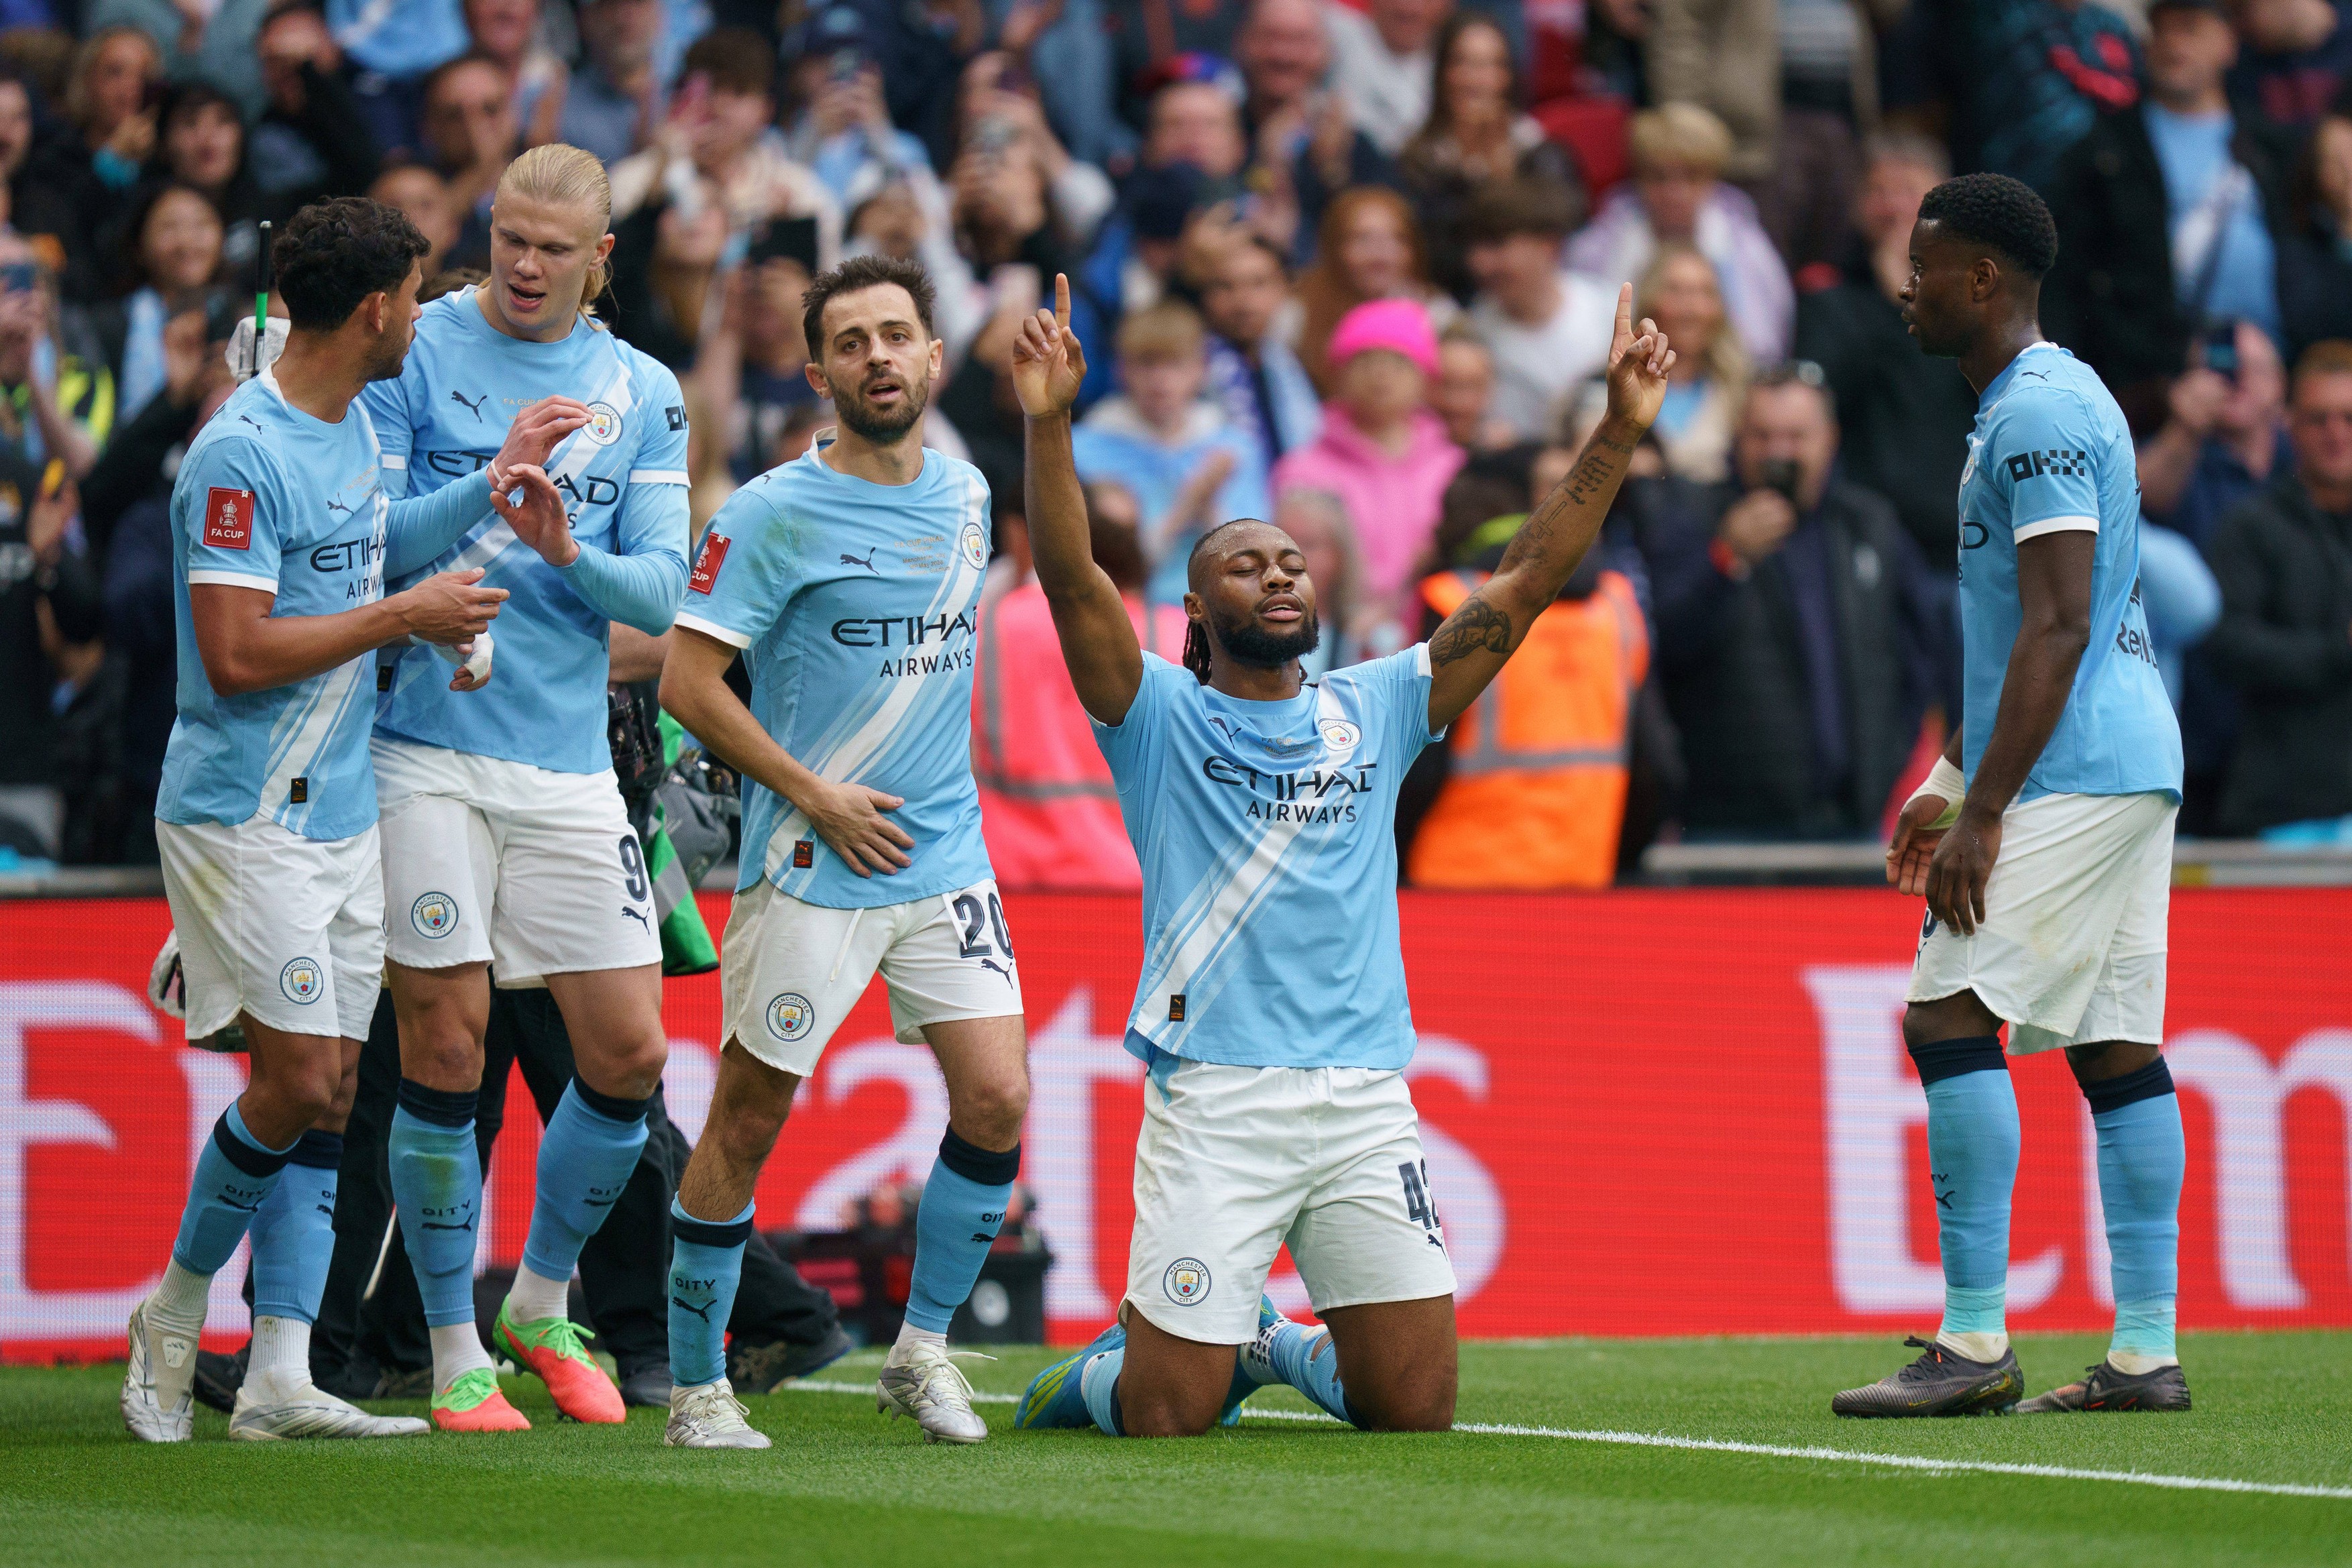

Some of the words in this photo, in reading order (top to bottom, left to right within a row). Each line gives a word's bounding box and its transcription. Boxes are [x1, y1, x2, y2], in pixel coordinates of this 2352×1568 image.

[427, 450, 619, 506] ETAD
[211, 528, 223, 537] FA
[223, 529, 245, 539] CUP
[310, 533, 386, 573] ETIHA
[879, 648, 972, 677] AIRWAYS
[1245, 800, 1357, 824] AIRWAYS
[619, 834, 647, 903] 9
[414, 895, 451, 915] MANCHESTER
[952, 892, 1014, 960] 20
[284, 960, 319, 978] MANCHESTER
[773, 996, 810, 1014] MANCHESTER
[981, 1211, 1007, 1223] CIT
[1169, 1261, 1207, 1278] MANCHESTER
[675, 1277, 716, 1290] CITY
